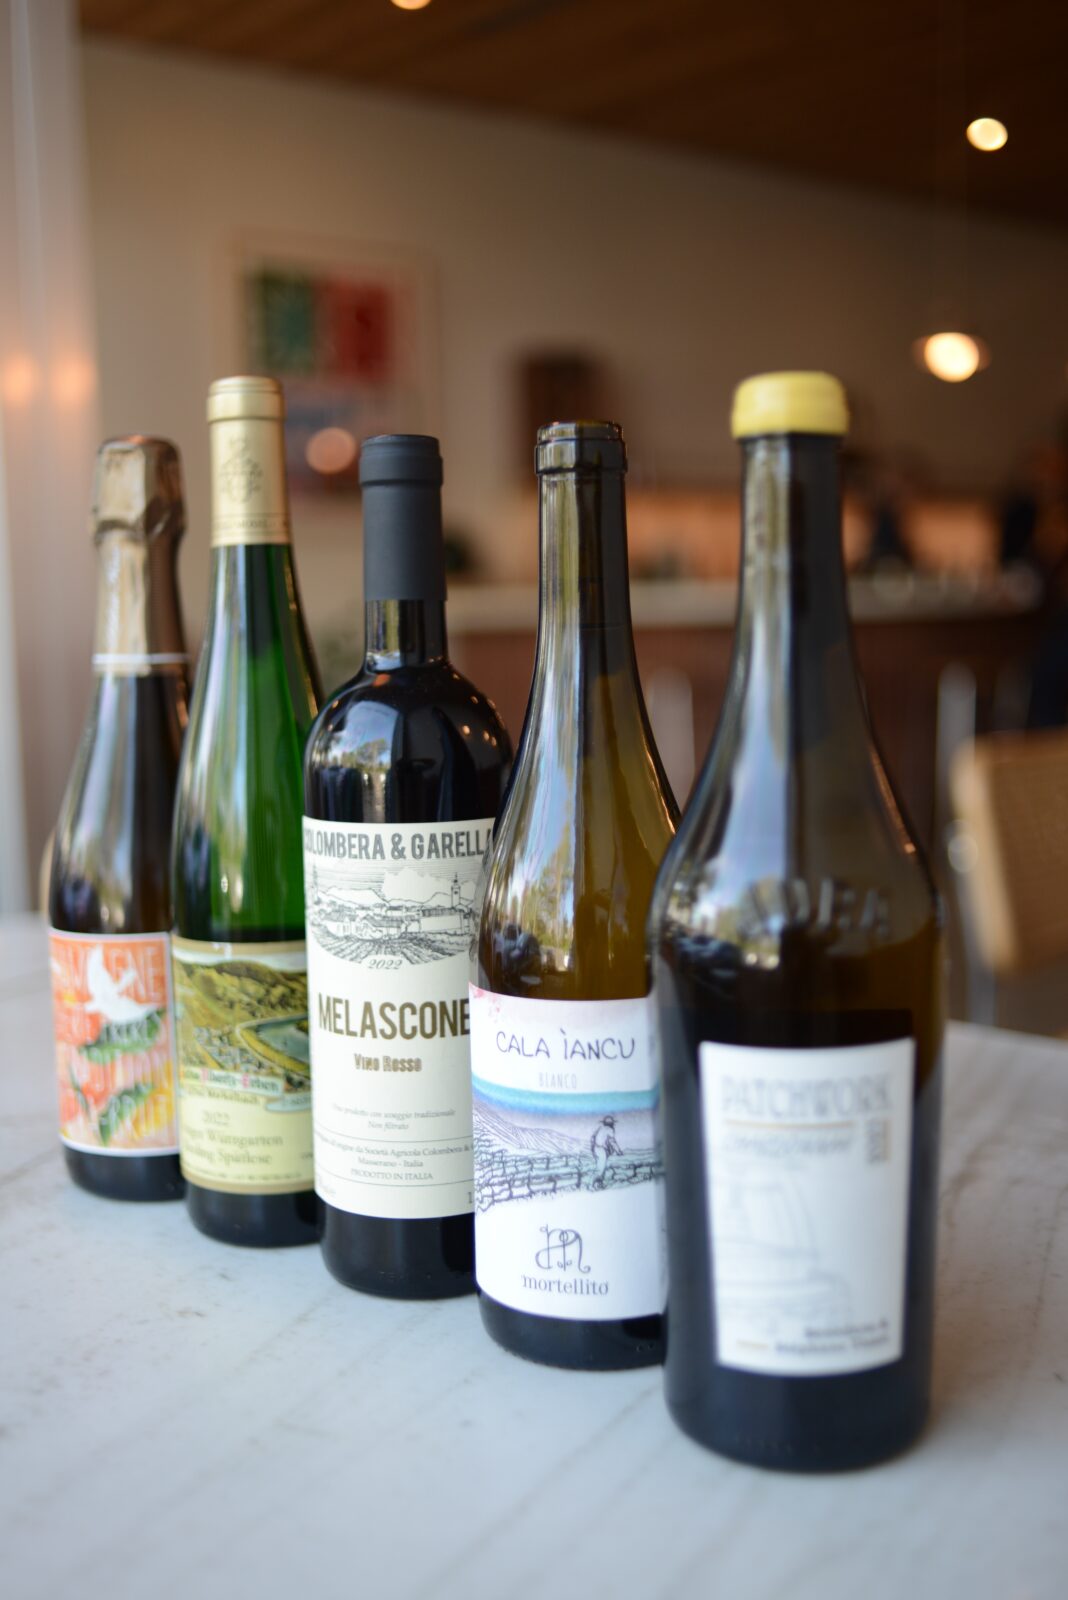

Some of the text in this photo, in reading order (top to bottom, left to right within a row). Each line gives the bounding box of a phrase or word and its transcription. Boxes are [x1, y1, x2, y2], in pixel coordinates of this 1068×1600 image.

[390, 833, 406, 860] &
[368, 959, 403, 970] 2022
[318, 993, 470, 1040] MELASCONE
[496, 1030, 551, 1059] CALA
